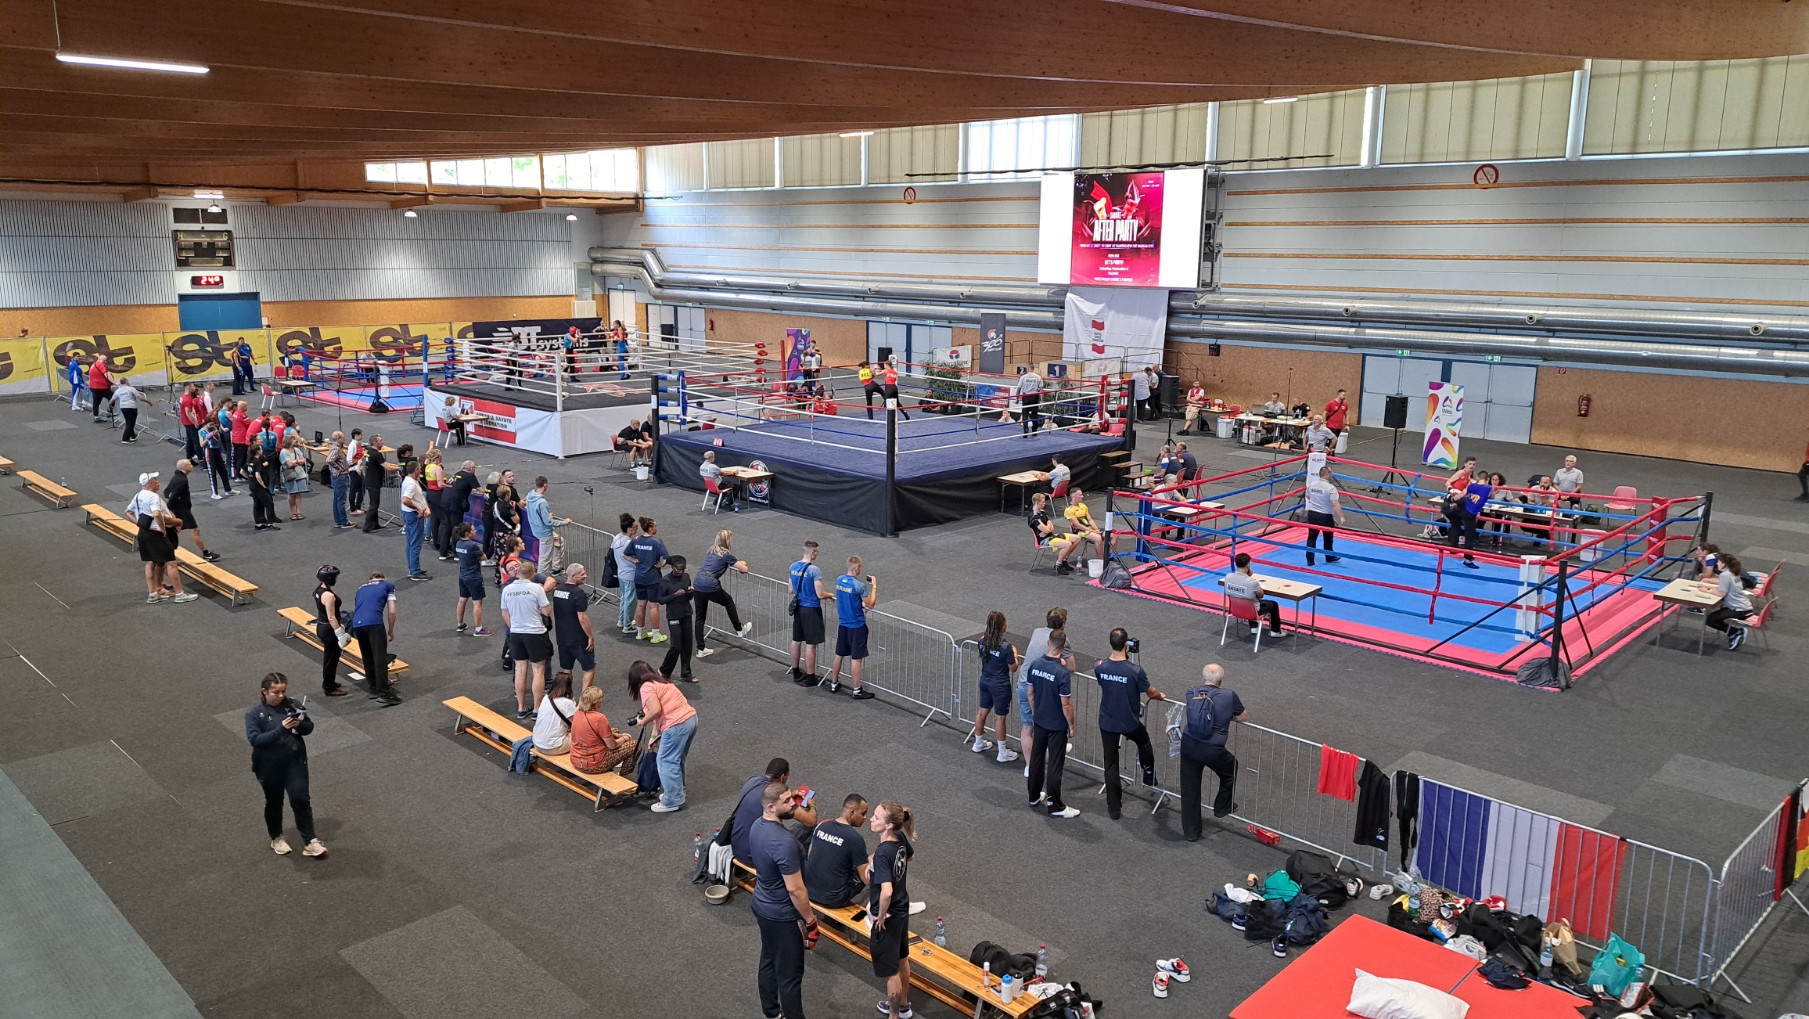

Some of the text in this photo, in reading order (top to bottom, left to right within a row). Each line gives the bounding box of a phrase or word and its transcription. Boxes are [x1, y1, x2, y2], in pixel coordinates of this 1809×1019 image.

[1092, 219, 1138, 241] AFTER PARTY
[1031, 668, 1056, 682] FRANCE
[1100, 673, 1128, 684] FRANCE
[816, 829, 844, 847] FRANCE
